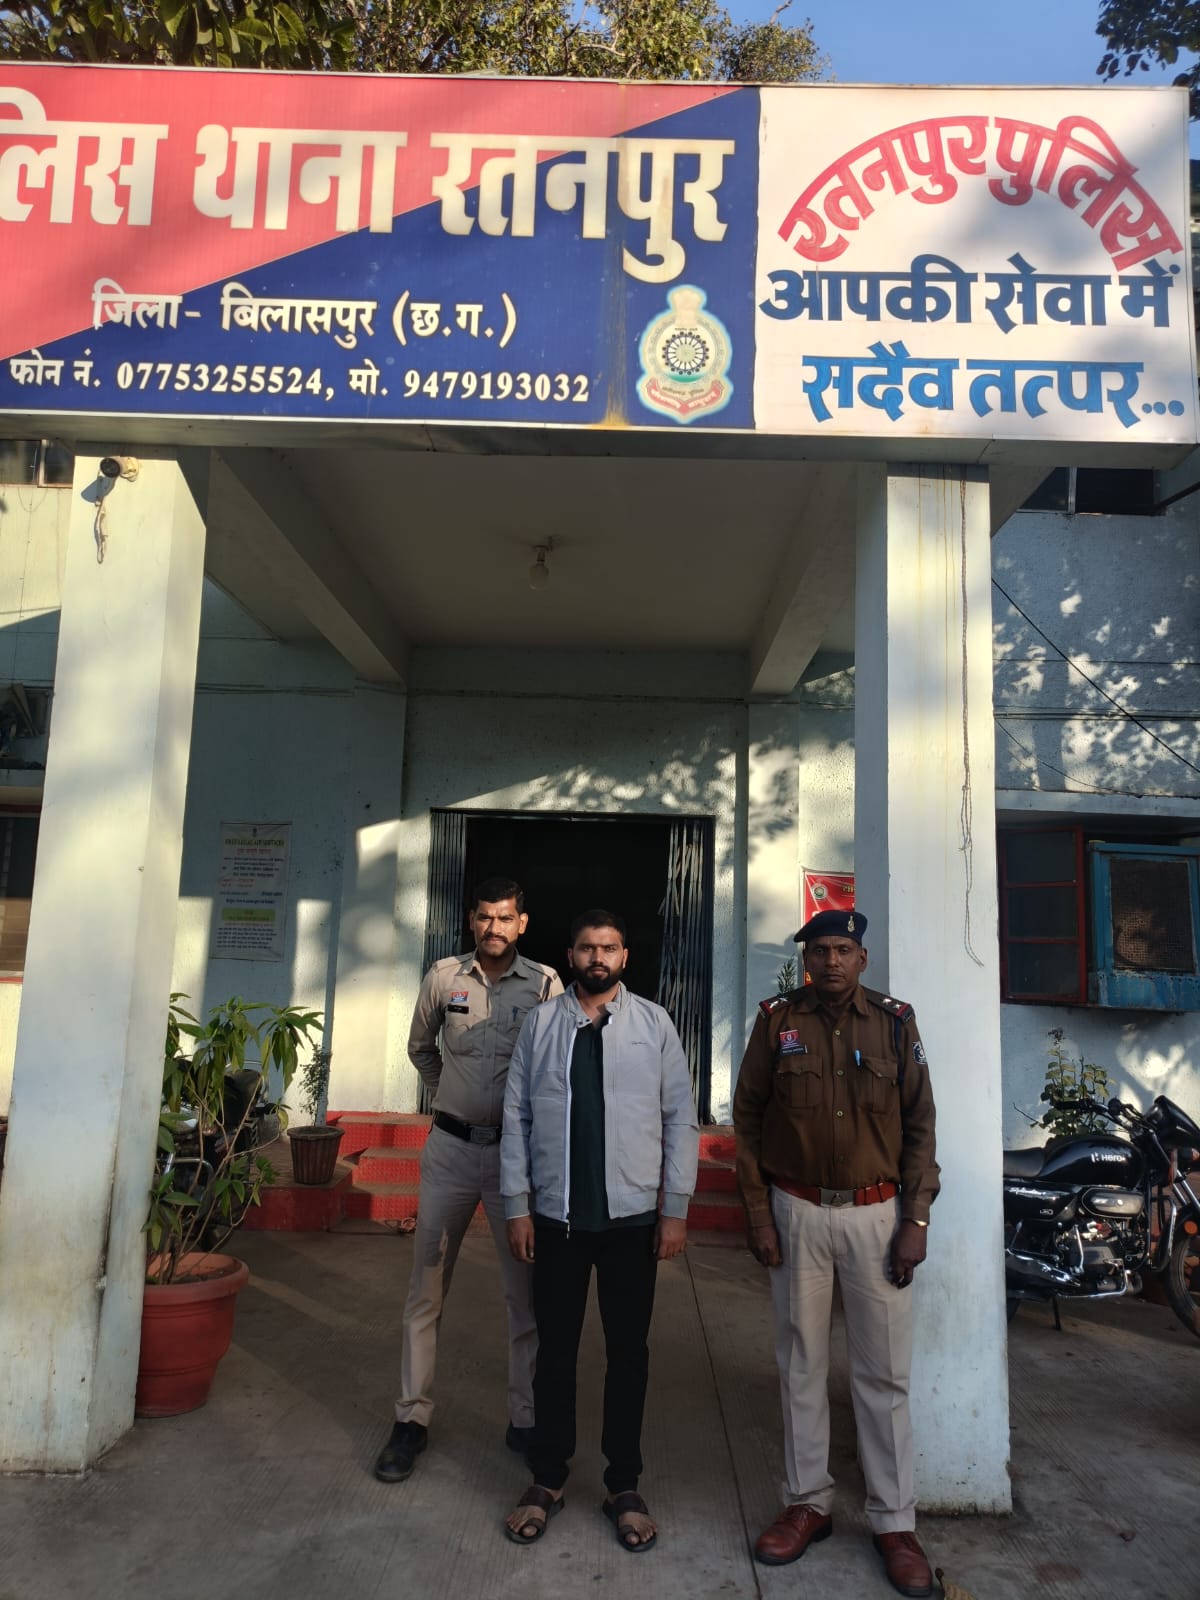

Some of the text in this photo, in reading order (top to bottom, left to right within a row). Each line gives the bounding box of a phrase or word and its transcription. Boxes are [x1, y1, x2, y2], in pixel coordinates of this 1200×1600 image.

[0, 87, 735, 283] लिस थाना रतनपुर
[778, 115, 1184, 271] रतनपुर पुलिस
[220, 282, 378, 349] बिलासपुर
[759, 252, 1180, 334] आपकी सेवा में
[10, 348, 589, 402] फोन नं. 07753255524, मो. 9479193032
[802, 340, 959, 422] सदैव
